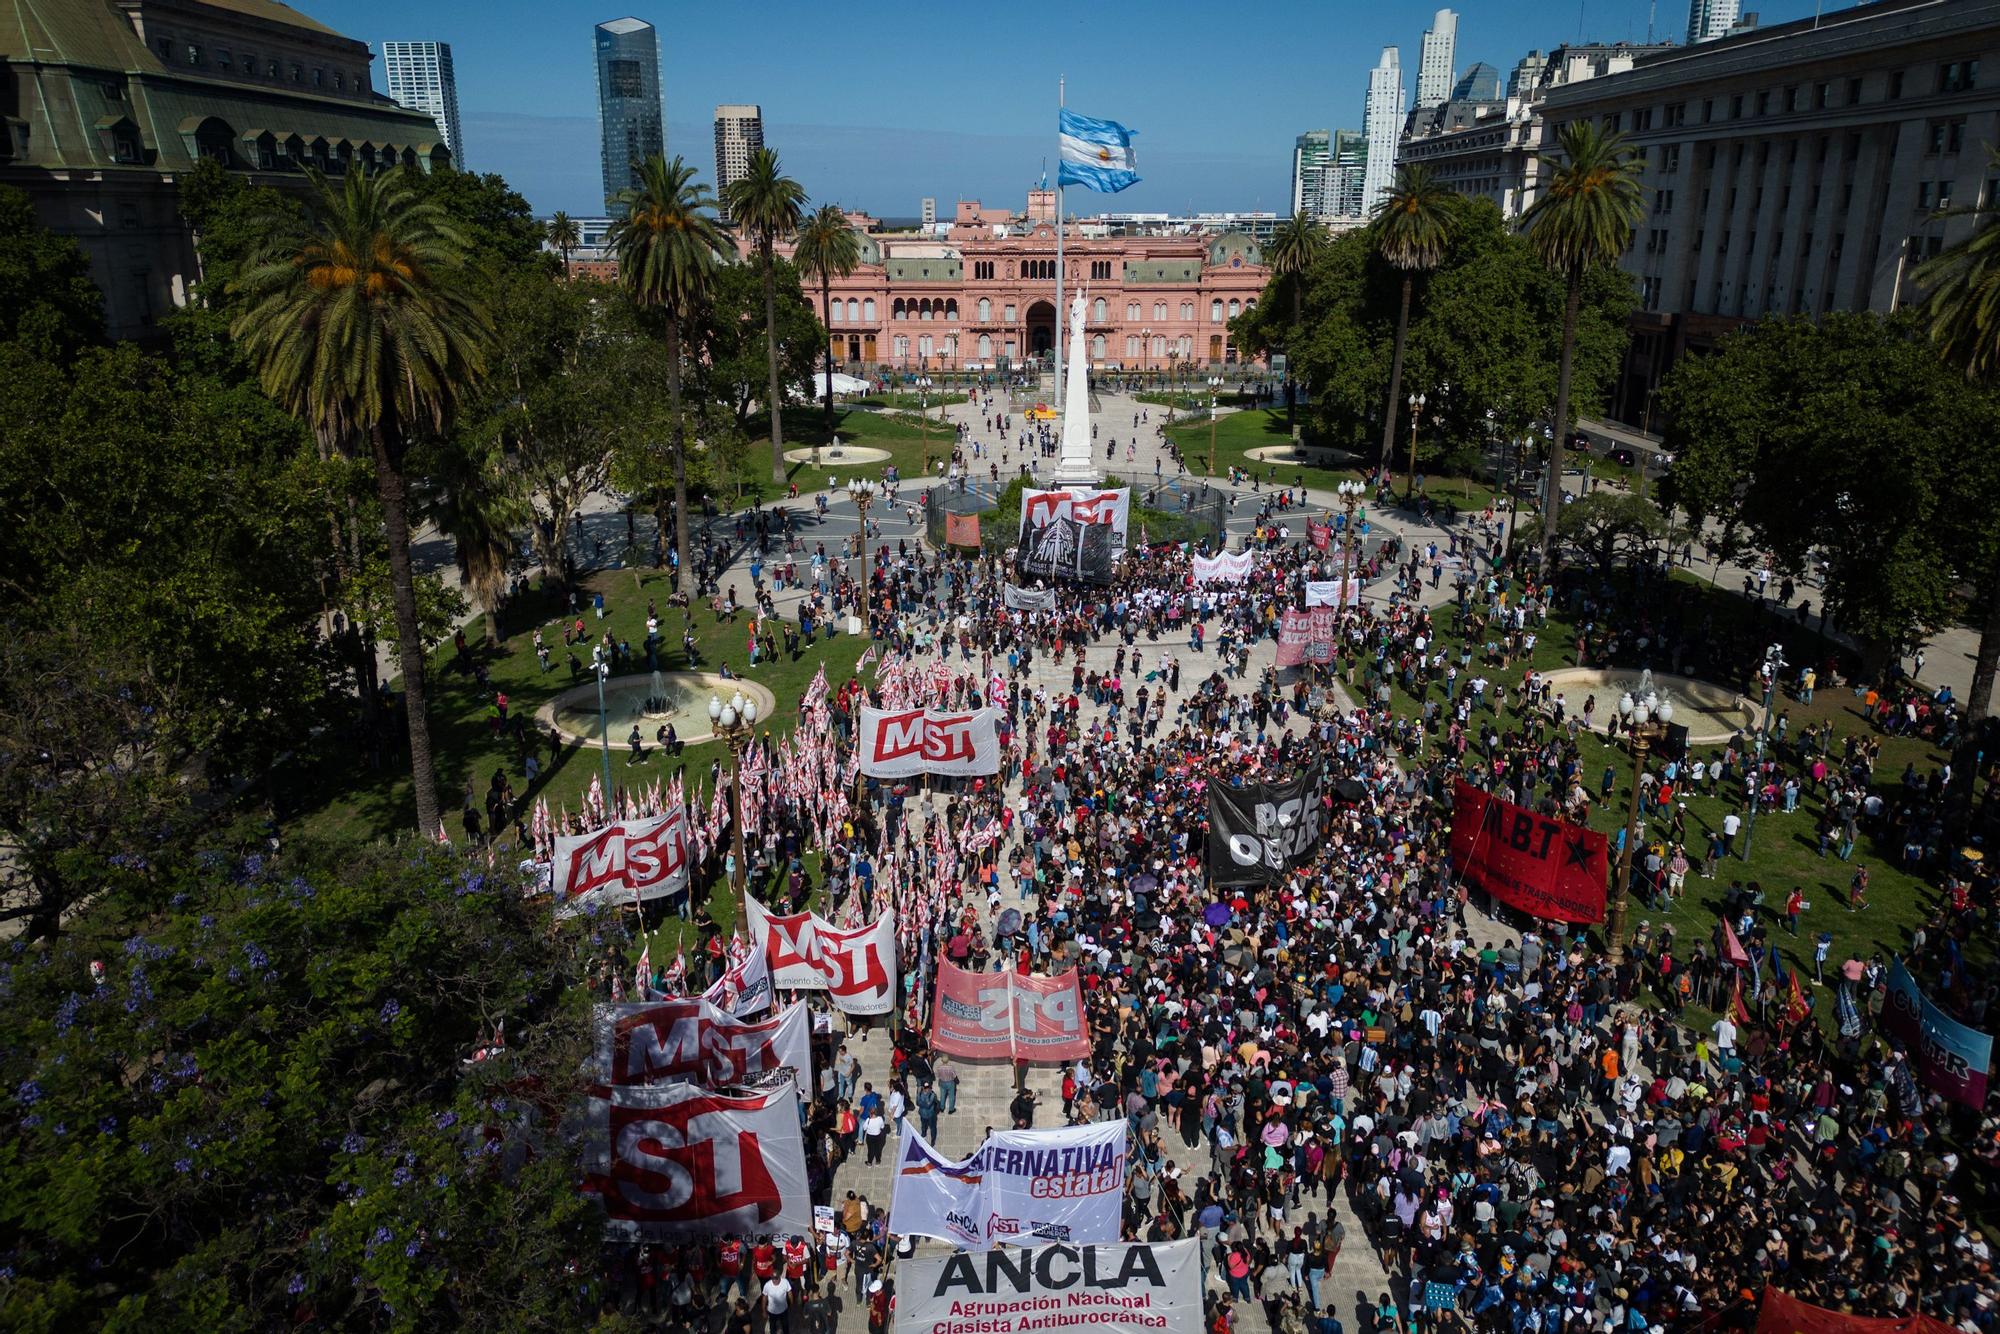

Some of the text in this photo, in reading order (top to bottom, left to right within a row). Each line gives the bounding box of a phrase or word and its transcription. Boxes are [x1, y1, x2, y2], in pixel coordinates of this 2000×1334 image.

[881, 714, 973, 758] MST
[574, 823, 681, 888] MST
[770, 917, 880, 989] MST
[774, 978, 811, 986] ovimiento
[841, 1001, 888, 1013] Trabajadores
[626, 1016, 773, 1081] MST
[1032, 1154, 1124, 1199] estatal
[945, 1211, 980, 1236] ANCLA
[933, 1244, 1166, 1297] ANCLA
[932, 1312, 1167, 1334] Clasista Antiburocrática
[949, 1292, 1151, 1319] Agrupación Nacional
